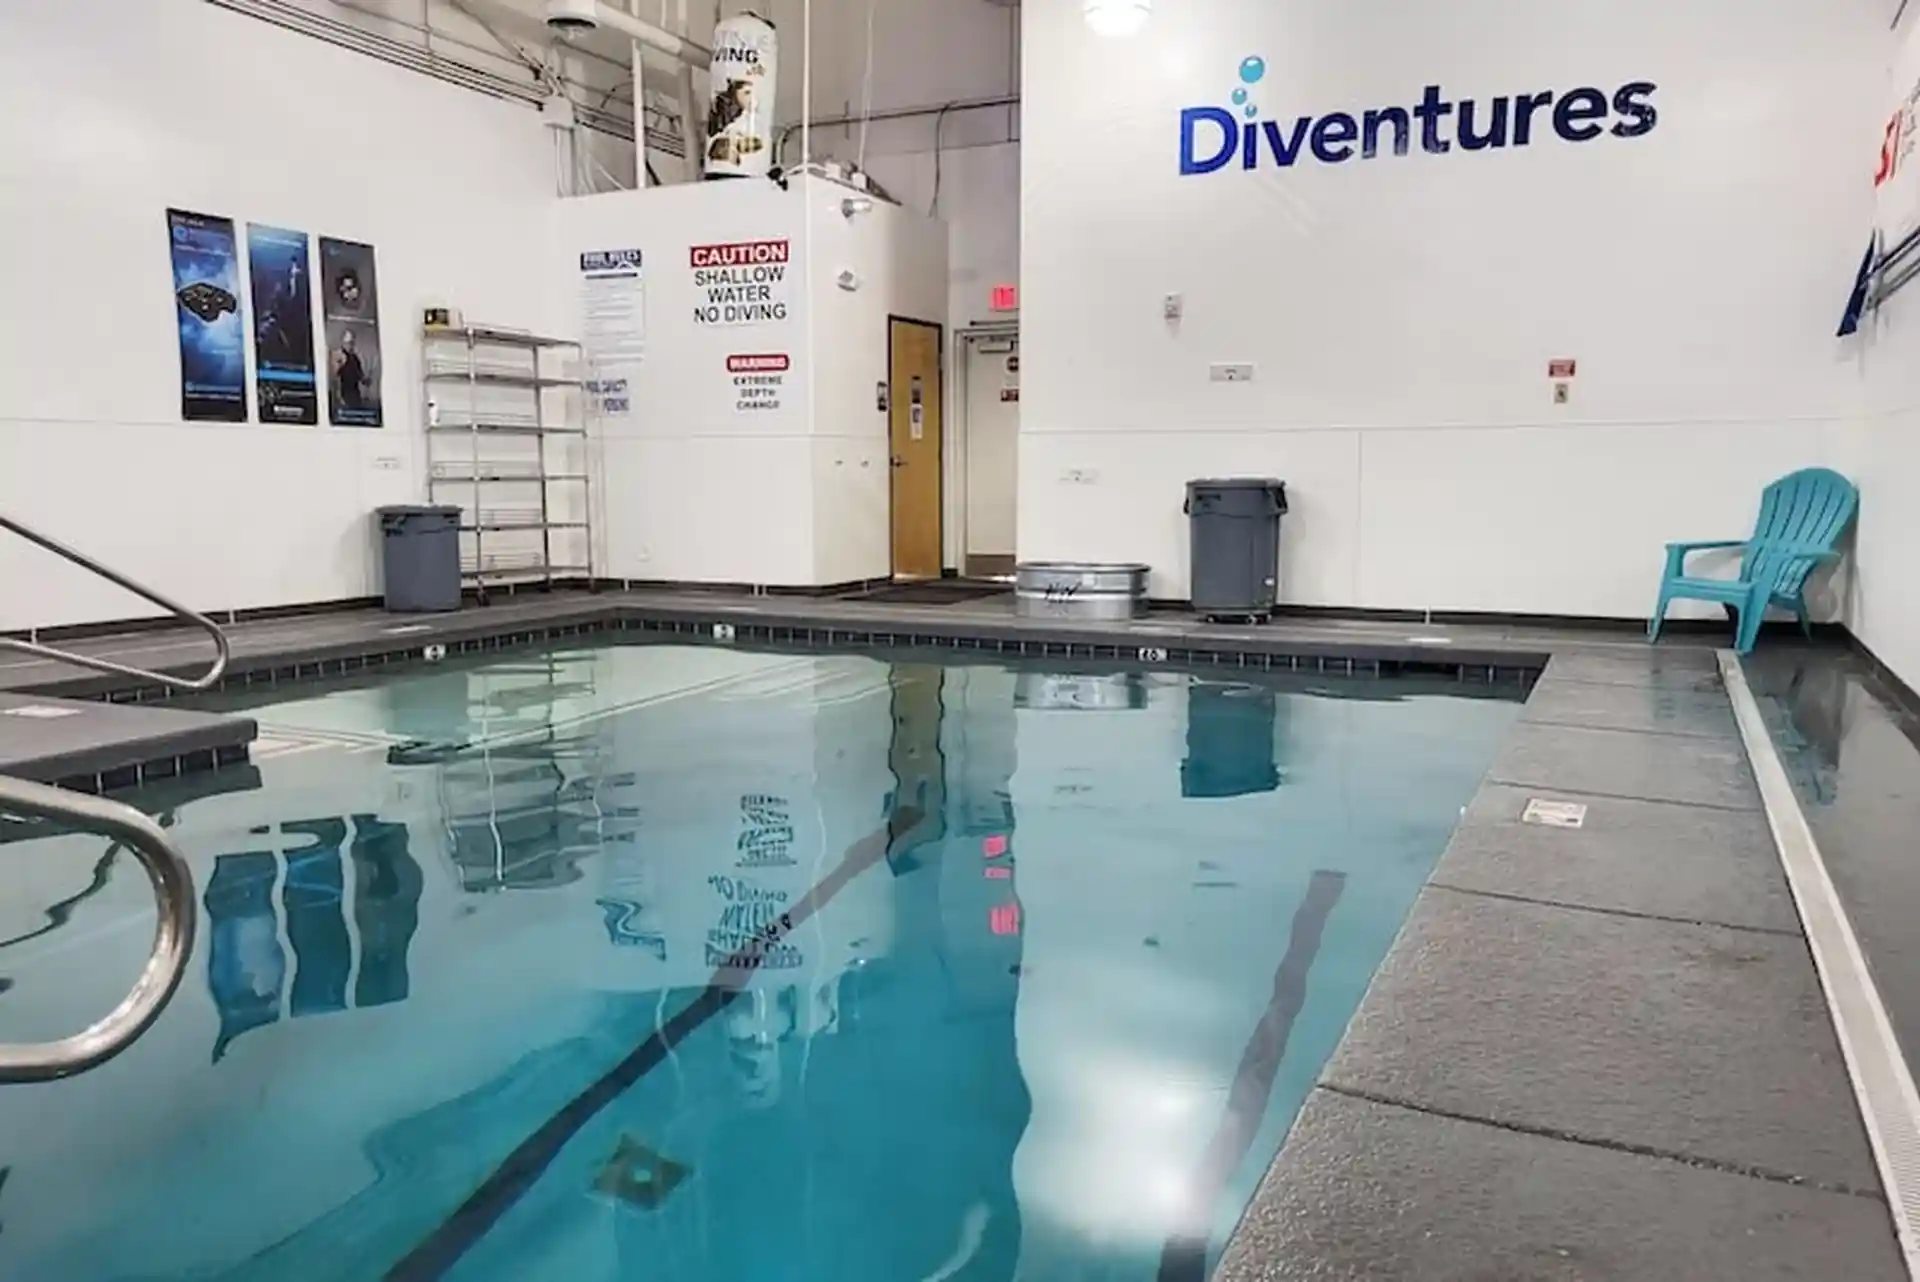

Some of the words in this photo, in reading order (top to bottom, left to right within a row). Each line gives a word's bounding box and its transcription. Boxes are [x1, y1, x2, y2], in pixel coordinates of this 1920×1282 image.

[1179, 81, 1657, 176] Diventures
[693, 244, 786, 265] CAUTION
[695, 266, 785, 287] SHALLOW
[708, 285, 770, 303] WATER
[693, 306, 719, 323] NO
[724, 302, 787, 321] DIVING
[733, 376, 782, 386] EXTREME
[740, 388, 776, 398] DEPTH
